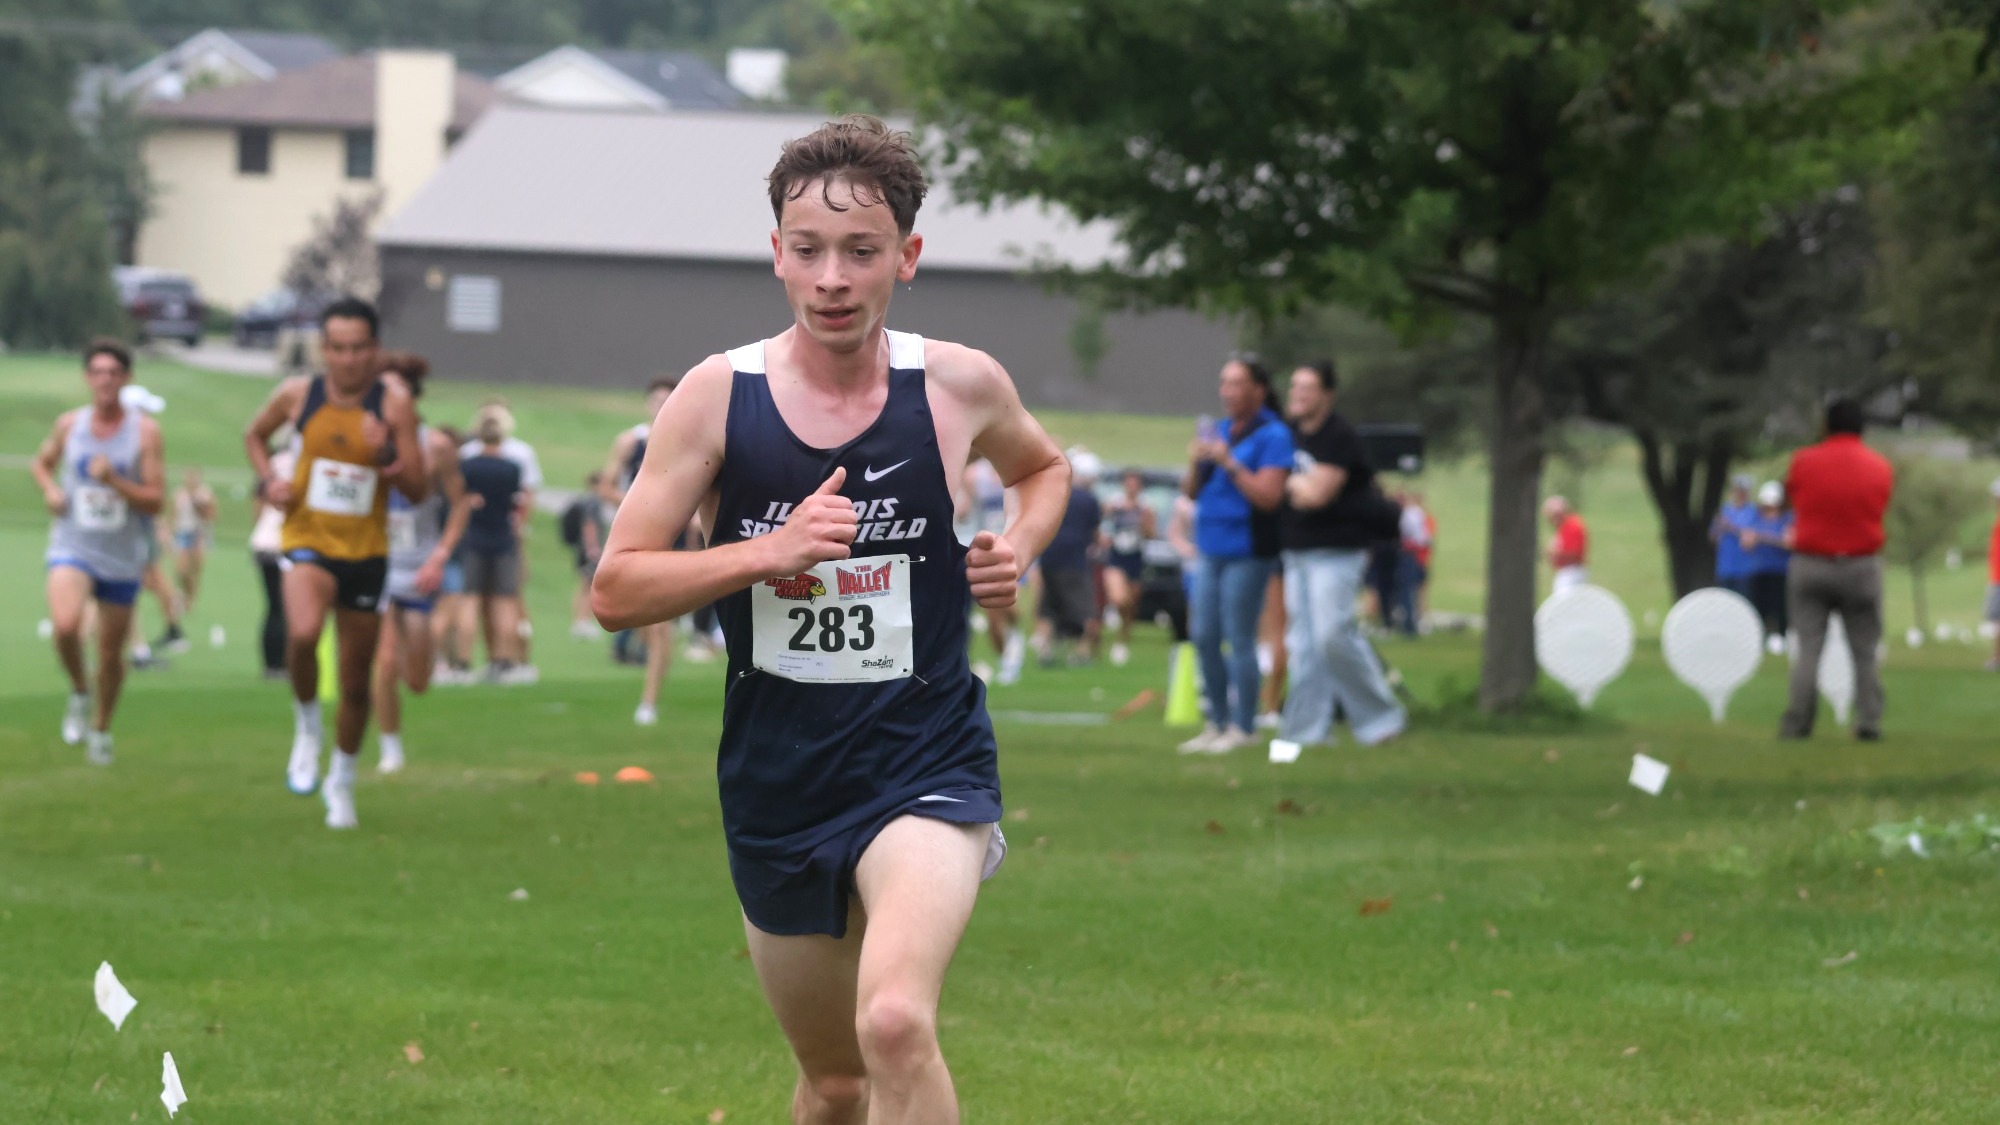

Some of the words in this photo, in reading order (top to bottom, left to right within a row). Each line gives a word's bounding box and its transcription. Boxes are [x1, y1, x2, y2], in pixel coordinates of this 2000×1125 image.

[762, 498, 900, 522] ILOIS
[738, 518, 928, 543] SPIELD
[835, 560, 893, 596] VALLEY
[854, 564, 873, 573] THE
[788, 604, 875, 653] 283
